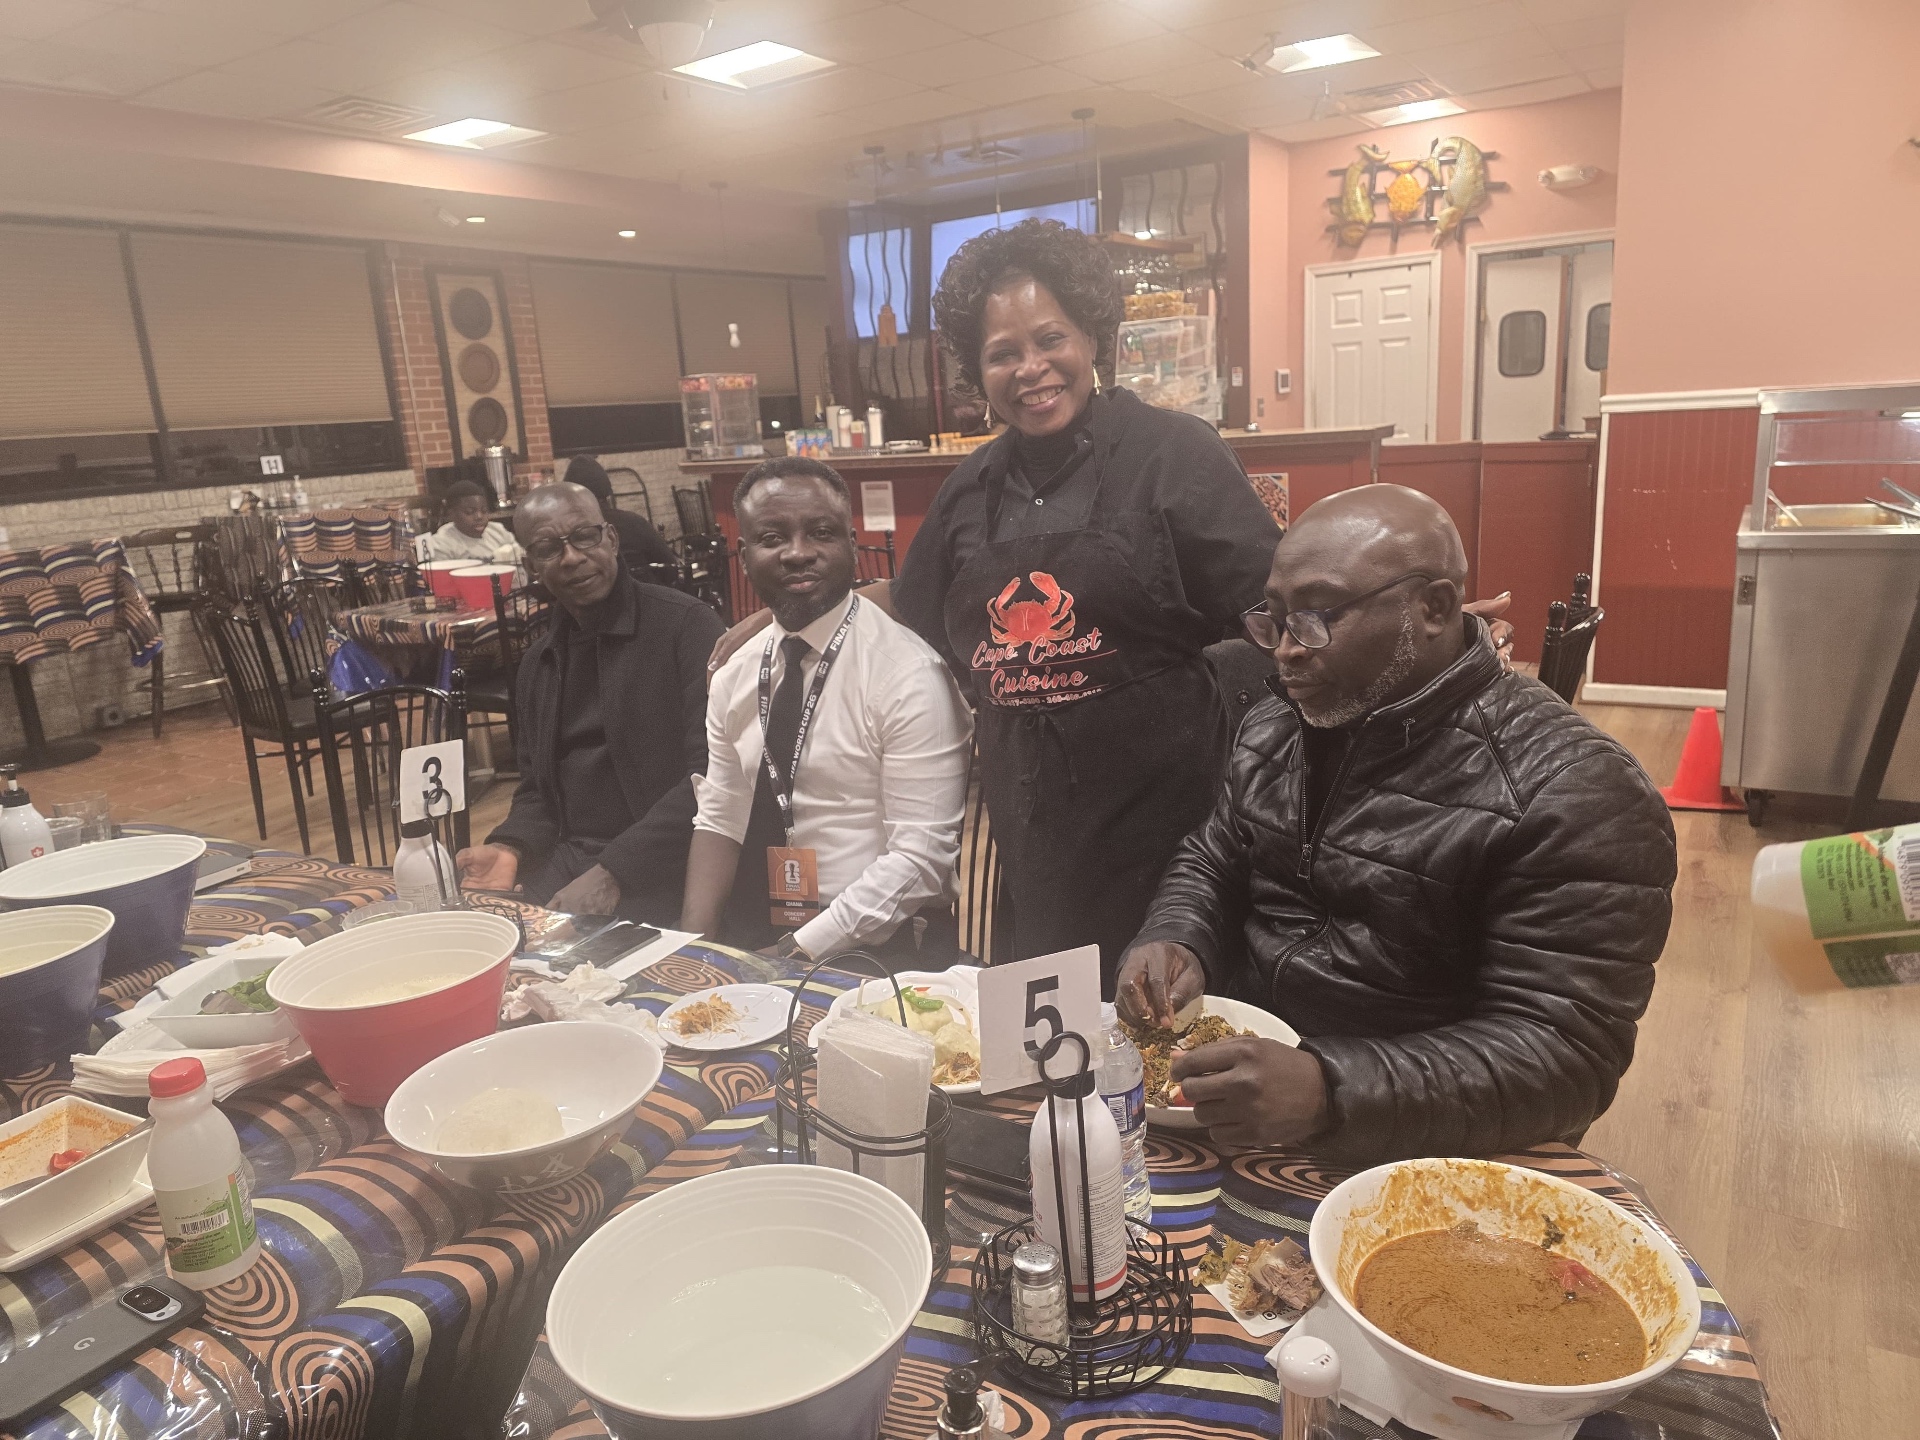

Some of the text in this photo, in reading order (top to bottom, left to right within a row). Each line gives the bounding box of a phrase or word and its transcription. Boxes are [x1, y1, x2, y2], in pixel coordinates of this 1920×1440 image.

[829, 622, 850, 651] FINAL
[971, 627, 1102, 671] Cape Coast
[990, 666, 1089, 698] Cuisine
[760, 696, 768, 714] FIFA
[793, 727, 805, 759] WORLD
[801, 708, 811, 727] CUP
[807, 695, 817, 708] 26
[422, 756, 443, 805] 3
[768, 764, 777, 779] 26
[1023, 974, 1063, 1062] 5
[73, 1337, 96, 1351] G
